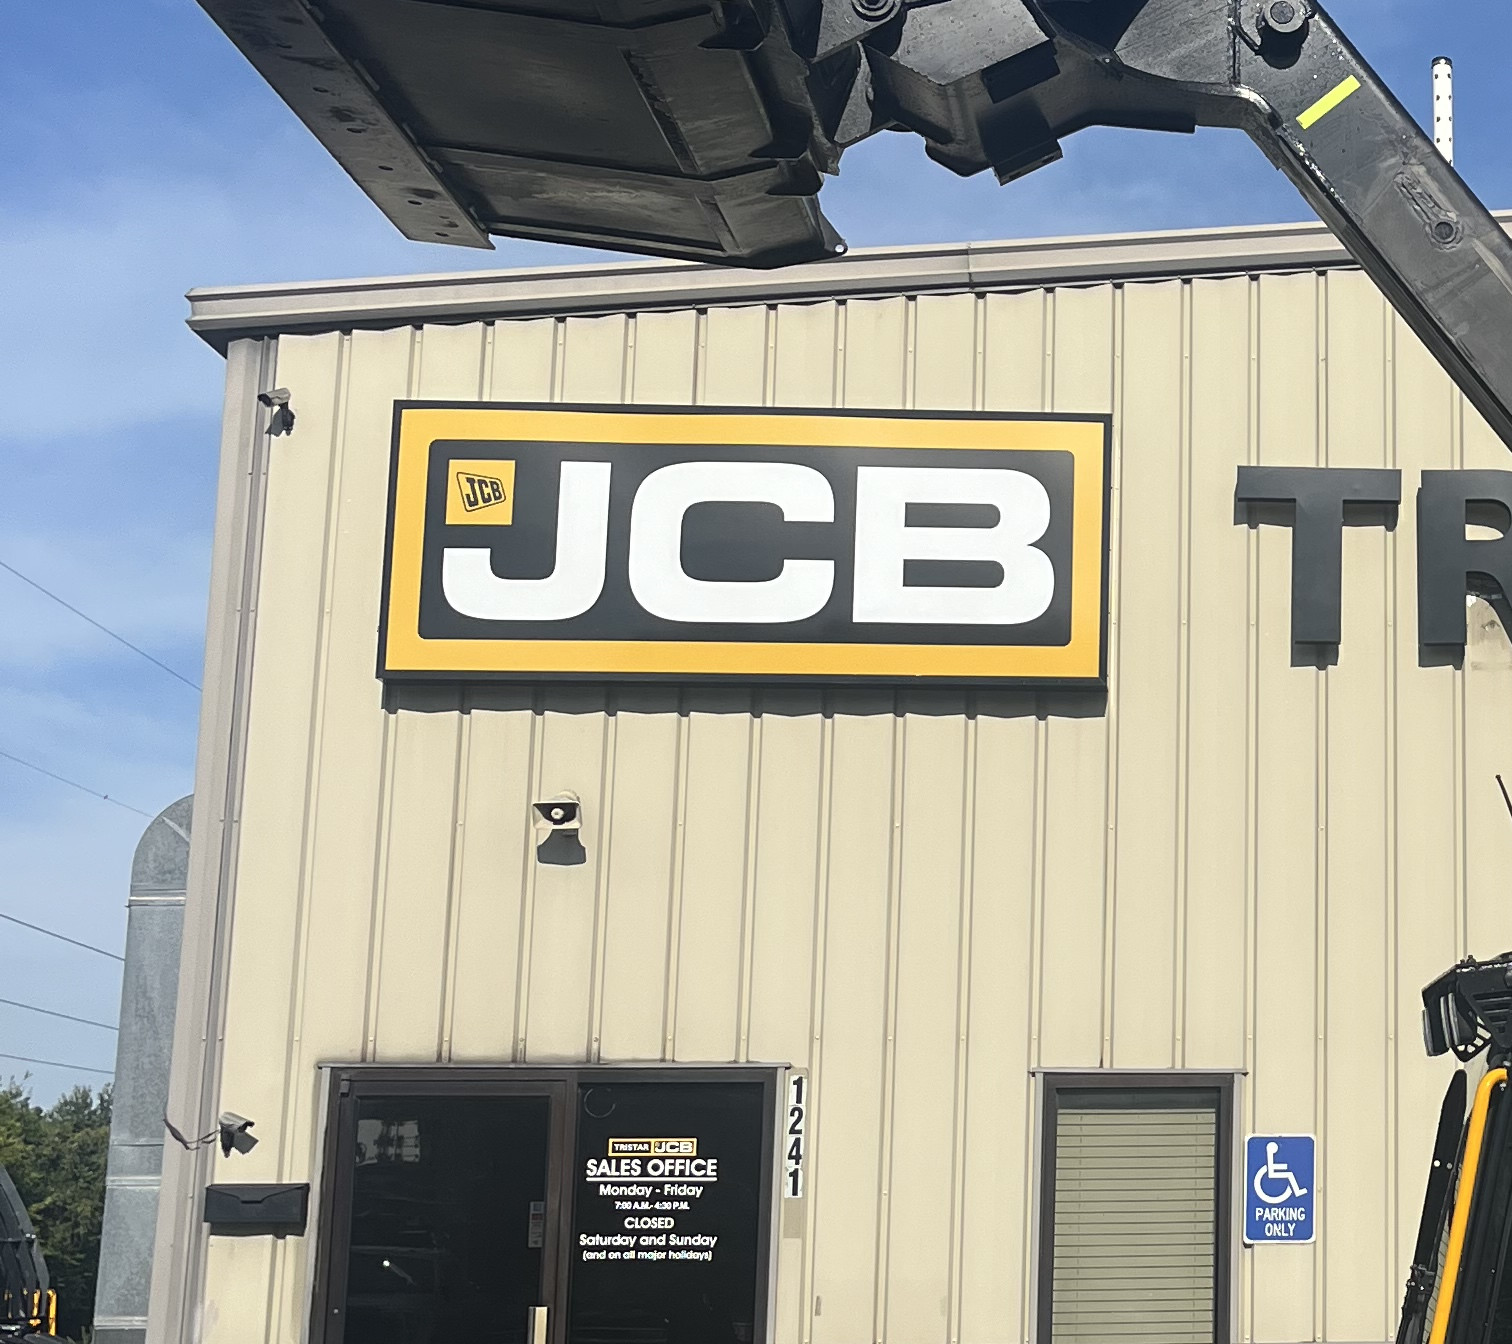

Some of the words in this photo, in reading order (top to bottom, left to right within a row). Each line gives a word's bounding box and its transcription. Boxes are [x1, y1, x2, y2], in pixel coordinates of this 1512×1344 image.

[465, 477, 503, 508] JCB
[442, 460, 1056, 625] JCB
[787, 1076, 804, 1197] 1241
[613, 1143, 650, 1152] TRISTAR
[654, 1141, 693, 1153] JCB
[586, 1158, 642, 1177] SALES
[647, 1158, 718, 1177] OFFICE
[599, 1184, 653, 1198] Monday
[663, 1184, 704, 1197] Friday
[1255, 1207, 1306, 1221] PARKING
[624, 1217, 675, 1229] CLOSED
[1264, 1223, 1297, 1237] ONLY
[579, 1234, 638, 1248] Saturday
[639, 1234, 667, 1246] and
[668, 1234, 718, 1248] Sunday
[582, 1250, 607, 1261] (and
[608, 1251, 621, 1260] on
[622, 1250, 636, 1260] all
[637, 1250, 667, 1261] major
[668, 1250, 713, 1261] holidays)
